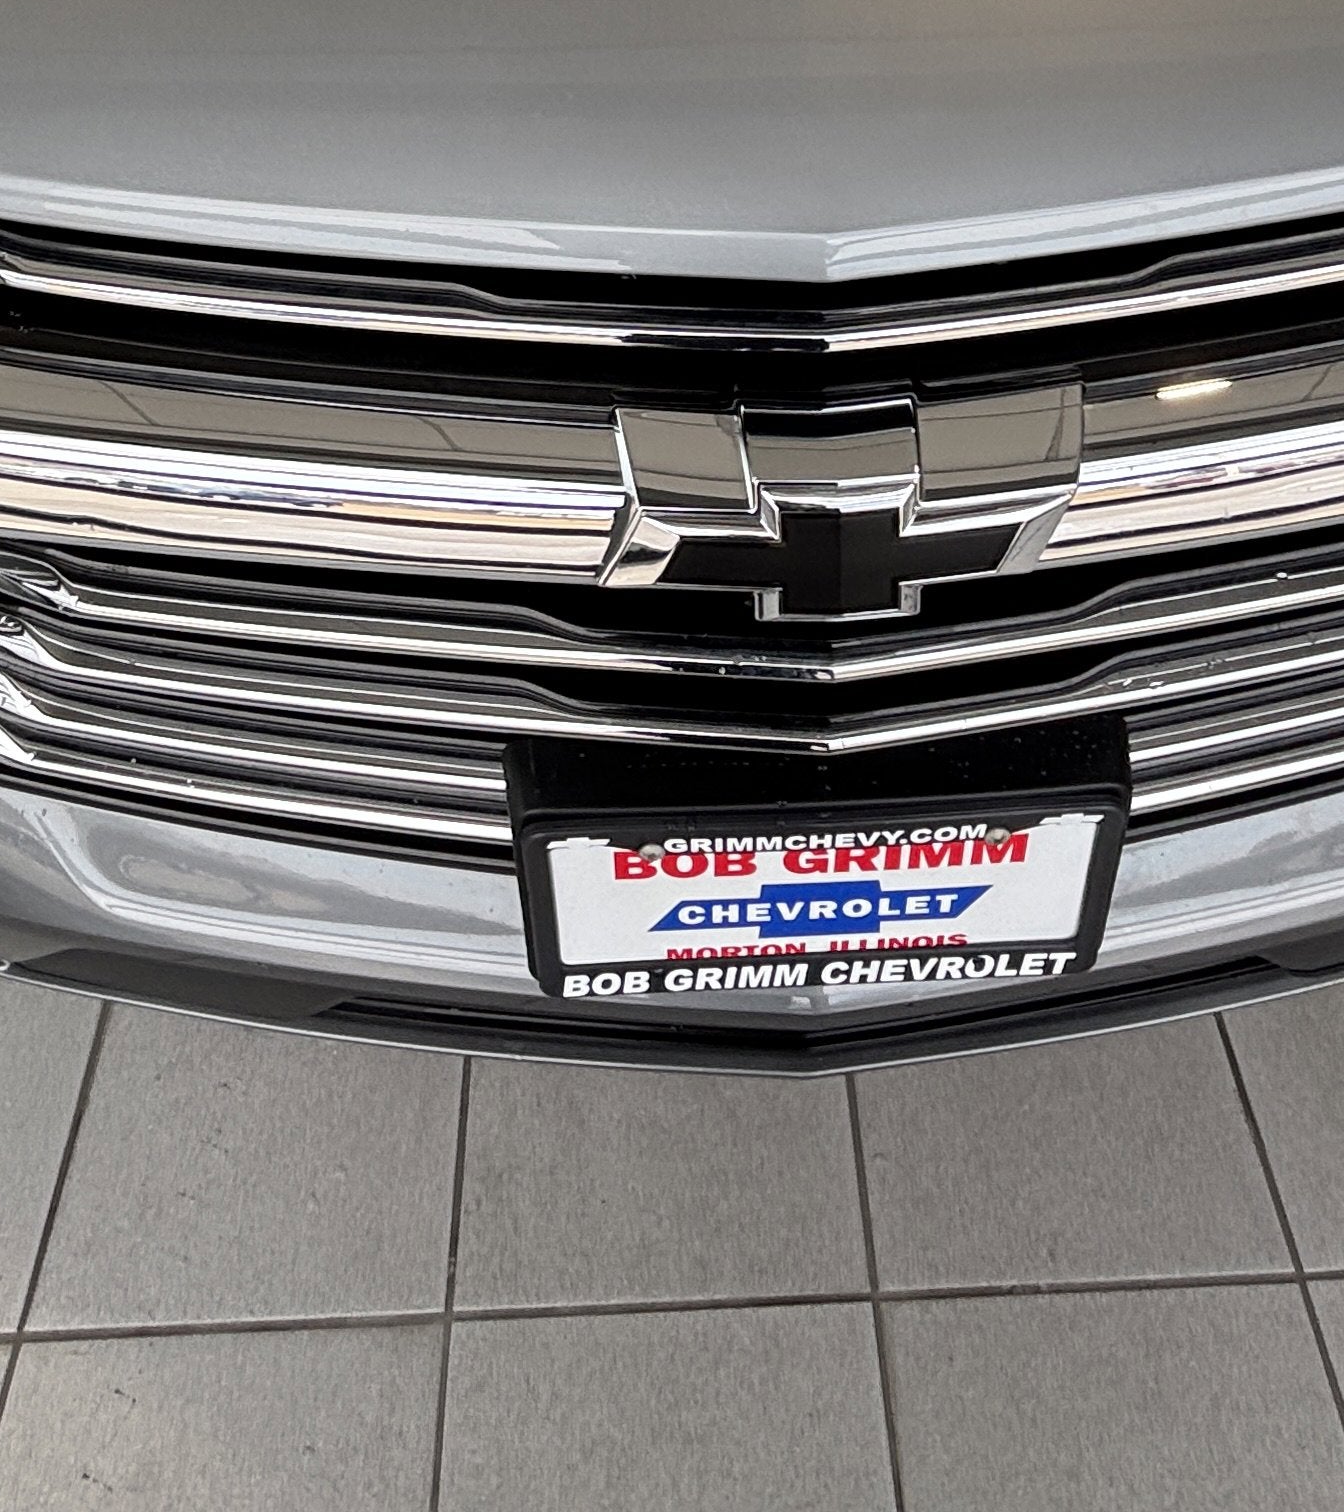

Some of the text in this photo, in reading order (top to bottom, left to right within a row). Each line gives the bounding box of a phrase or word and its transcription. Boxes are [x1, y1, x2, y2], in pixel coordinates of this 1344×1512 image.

[614, 833, 1029, 880] BOB GRIMM
[663, 823, 988, 853] GRIMMCHEVY.COM
[677, 894, 959, 925] CHEVROLET
[563, 952, 1076, 998] BOB GRIMM CHEVROLET
